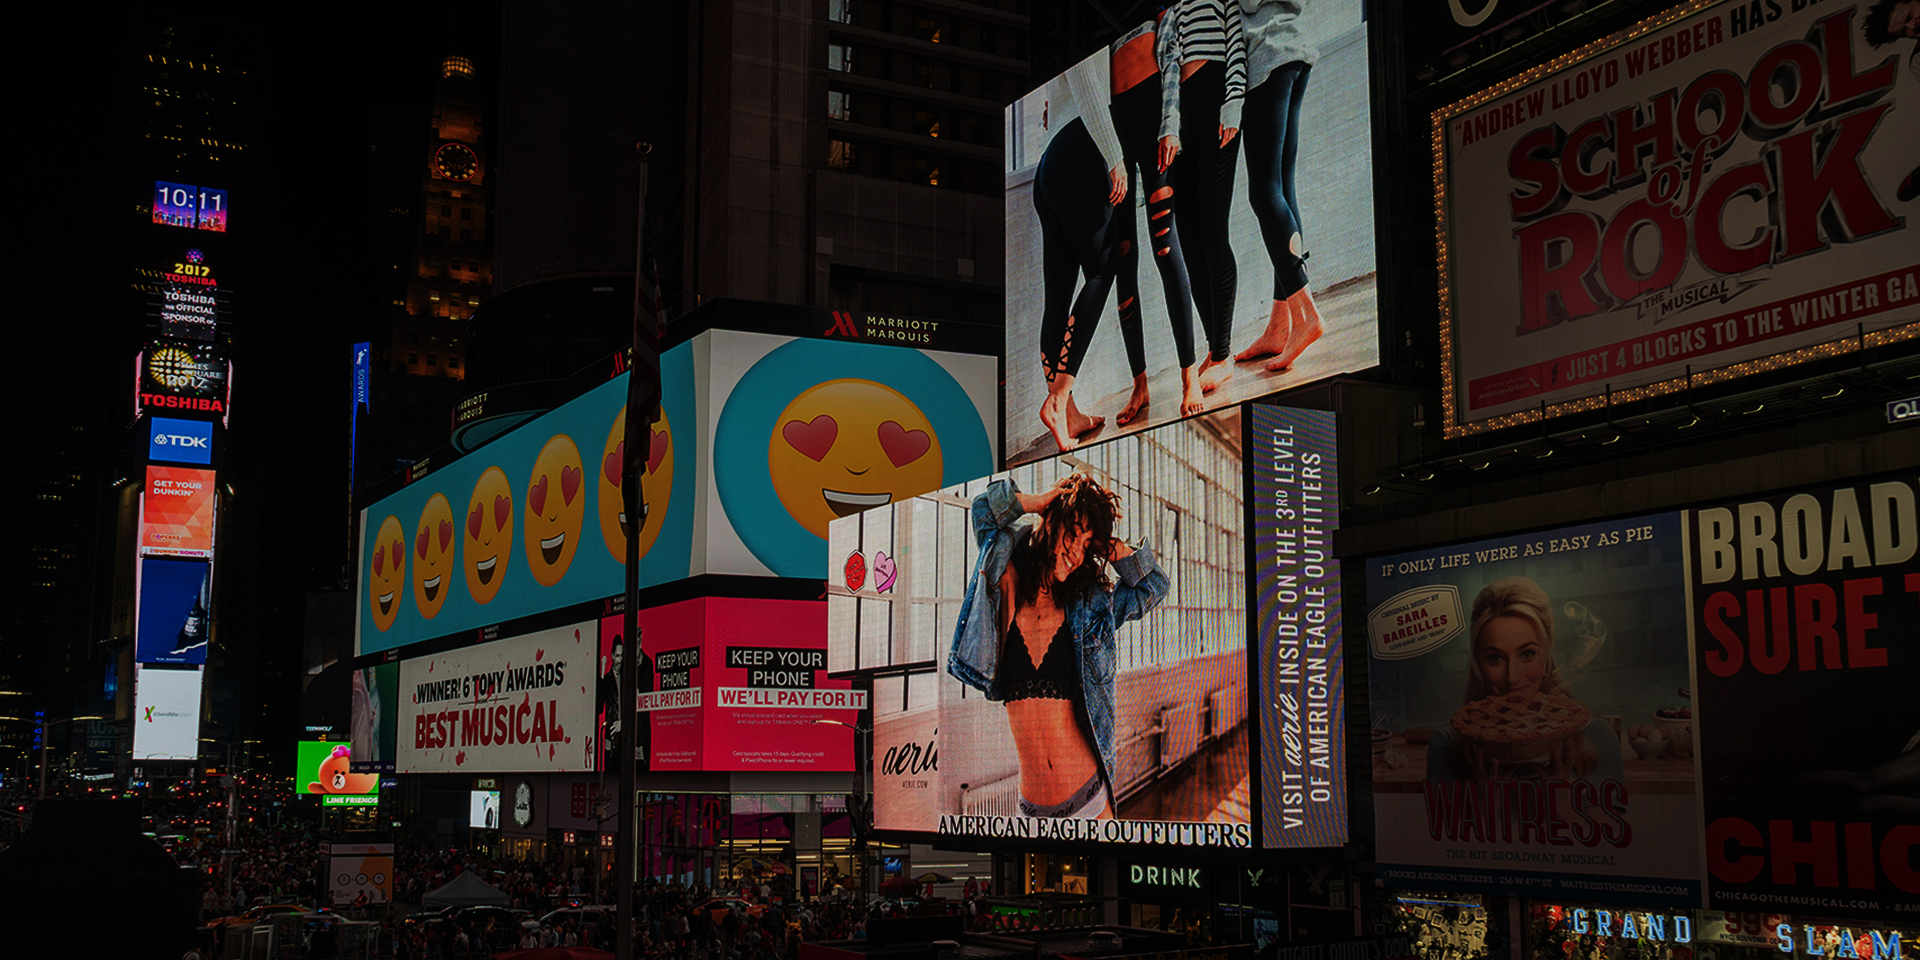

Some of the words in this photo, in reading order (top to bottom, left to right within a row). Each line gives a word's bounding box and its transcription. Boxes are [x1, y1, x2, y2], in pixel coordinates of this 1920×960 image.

[1552, 59, 1619, 110] LLOYD
[1625, 16, 1723, 79] WEBBER
[1731, 0, 1782, 38] HAS
[1508, 5, 1899, 221] SCHOOL
[1646, 134, 1719, 218] of
[159, 187, 221, 212] 10:11
[1514, 102, 1906, 337] ROCK
[164, 272, 217, 287] TOSHIBA
[174, 263, 210, 277] 2017
[165, 291, 217, 304] TOSHIBA
[175, 303, 214, 315] OFFICIAL
[1642, 291, 1665, 308] THE
[1660, 281, 1729, 316] MUSICAL
[163, 312, 206, 324] SPONSOR
[867, 315, 939, 332] MARRIOTT
[1566, 350, 1609, 381] JUST
[1616, 348, 1627, 369] 4
[1633, 326, 1707, 373] BLOCKS
[1712, 318, 1738, 346] TO
[1743, 311, 1784, 339] THE
[1789, 283, 1880, 326] WINTER
[866, 328, 931, 343] MARQUIS
[357, 368, 366, 403] AWARDS
[141, 393, 223, 412] TOSHIBA
[167, 434, 208, 448] TDK
[1273, 425, 1295, 483] LEVEL
[154, 480, 174, 488] GET
[175, 481, 202, 490] YOUR
[1275, 489, 1296, 520] 3RD
[1301, 452, 1325, 579] OUTFITTERS
[1275, 527, 1297, 567] THE
[1698, 481, 1919, 585] BROAD
[1381, 564, 1394, 577] IF
[1398, 557, 1436, 575] ONLY
[1440, 553, 1470, 570] LIFE
[1475, 545, 1518, 564] WERE
[1523, 542, 1544, 557] AS
[1549, 533, 1592, 554] EASY
[1597, 530, 1620, 547] AS
[1625, 525, 1653, 543] PIE
[1277, 574, 1299, 604] ON
[1304, 585, 1327, 649] EAGLE
[1381, 604, 1410, 619] ORIGINAL
[1410, 596, 1431, 609] MUSIC
[1430, 593, 1440, 602] BY
[1396, 607, 1429, 626] SARA
[1383, 614, 1448, 645] BAREILLES
[1703, 576, 1889, 678] SURE
[657, 653, 675, 670] KEEP
[675, 650, 698, 667] YOUR
[732, 650, 774, 665] KEEP
[777, 651, 822, 667] YOUR
[1278, 611, 1300, 684] INSIDE
[417, 676, 462, 704] WINNER!
[463, 678, 470, 698] 6
[472, 670, 505, 696] TONY
[505, 660, 565, 692] AWARDS
[662, 671, 688, 688] PHONE
[753, 671, 810, 687] PHONE
[660, 692, 675, 708] PAY
[675, 691, 691, 706] FOR
[692, 690, 701, 705] IT
[777, 691, 809, 706] PAY
[812, 692, 846, 707] FOR
[850, 692, 865, 707] IT
[1307, 657, 1330, 769] AMERICAN
[415, 711, 459, 749] BEST
[1274, 691, 1302, 767] aerie
[325, 796, 348, 805] LINE
[348, 796, 379, 805] FRIENDS
[1282, 770, 1304, 830] VISIT
[1310, 775, 1331, 803] OF
[1423, 778, 1632, 848] WAITRESS
[938, 815, 1031, 838] AMERICAN
[1036, 817, 1099, 842] EAGLE
[1103, 821, 1252, 849] OUTFITTERS
[1445, 849, 1466, 860] THE
[1468, 849, 1487, 861] HIT
[1491, 850, 1557, 864] BROADWAY
[1561, 853, 1617, 867] MUSICAL
[1706, 816, 1920, 896] CHIC
[1129, 864, 1201, 889] DRINK
[1388, 869, 1417, 879] BROOKS
[1417, 871, 1457, 882] ATKINSON
[1459, 874, 1494, 884] THEATRE
[1500, 876, 1513, 885] 256
[1714, 890, 1880, 910] CHICAGOTHEMUSICAL.COM
[1573, 908, 1692, 944] GRAND
[1720, 933, 1734, 941] NYC
[1736, 934, 1768, 943] SOUVENIR
[1776, 923, 1904, 960] SLAM
